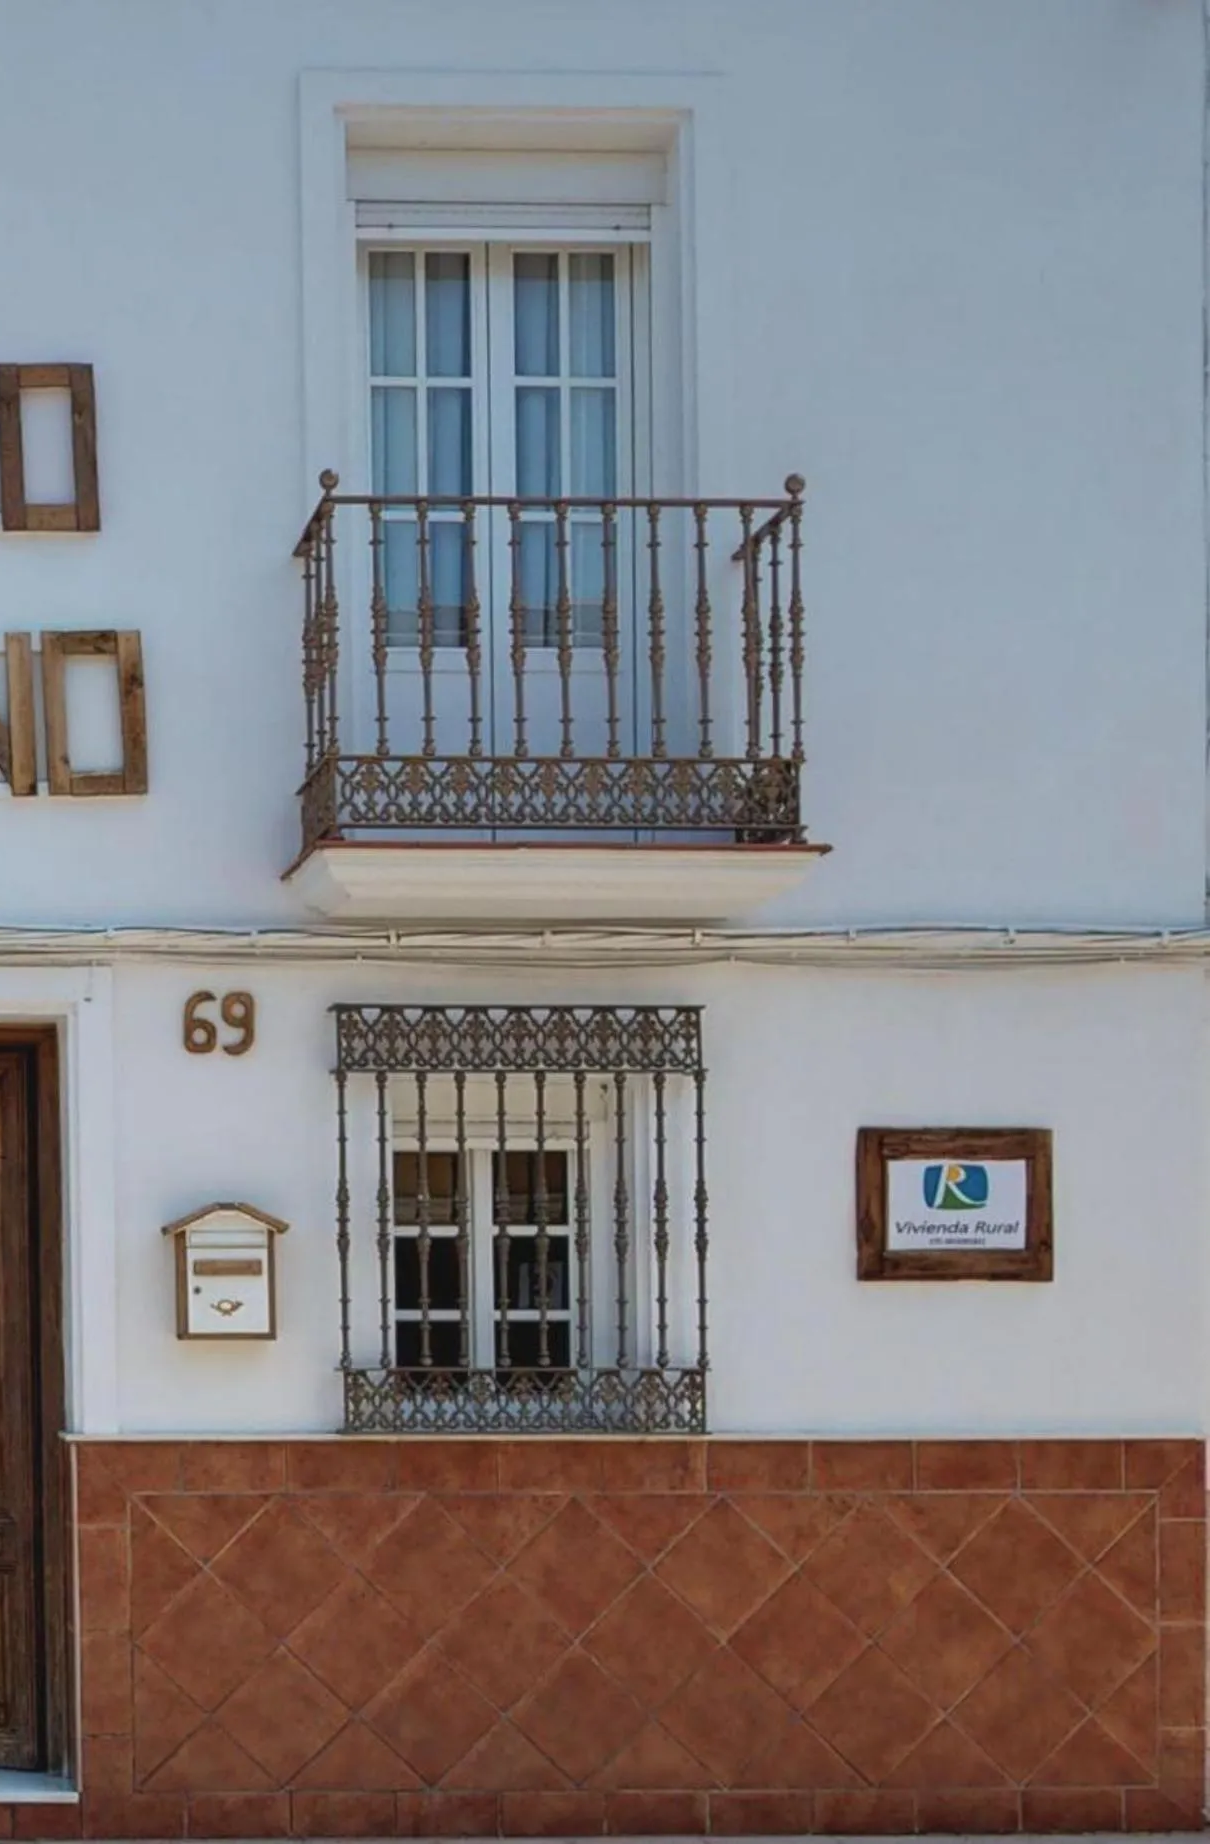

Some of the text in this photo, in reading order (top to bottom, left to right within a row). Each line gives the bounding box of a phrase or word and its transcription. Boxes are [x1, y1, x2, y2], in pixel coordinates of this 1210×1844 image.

[184, 990, 255, 1055] 69
[896, 1221, 1019, 1234] Vivienda Rural
